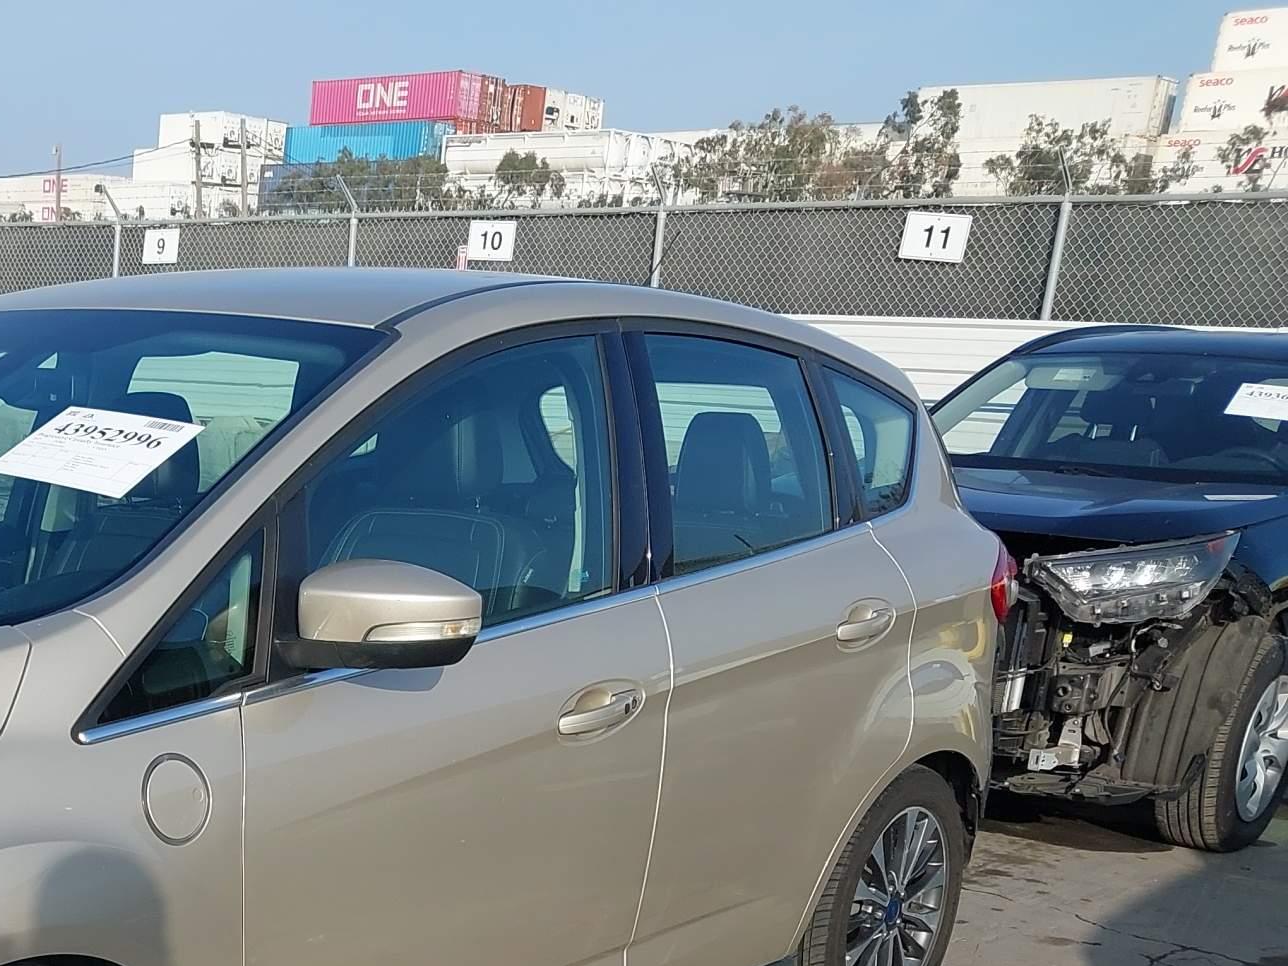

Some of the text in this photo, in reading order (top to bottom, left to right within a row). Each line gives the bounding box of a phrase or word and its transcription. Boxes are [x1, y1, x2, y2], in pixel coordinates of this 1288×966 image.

[1233, 16, 1269, 26] seaco
[1199, 77, 1234, 87] seaco
[357, 81, 409, 109] ONE
[1168, 138, 1201, 147] seaco
[481, 230, 502, 250] 10
[923, 225, 951, 249] 11
[157, 238, 165, 255] 9
[54, 422, 169, 449] 43952996
